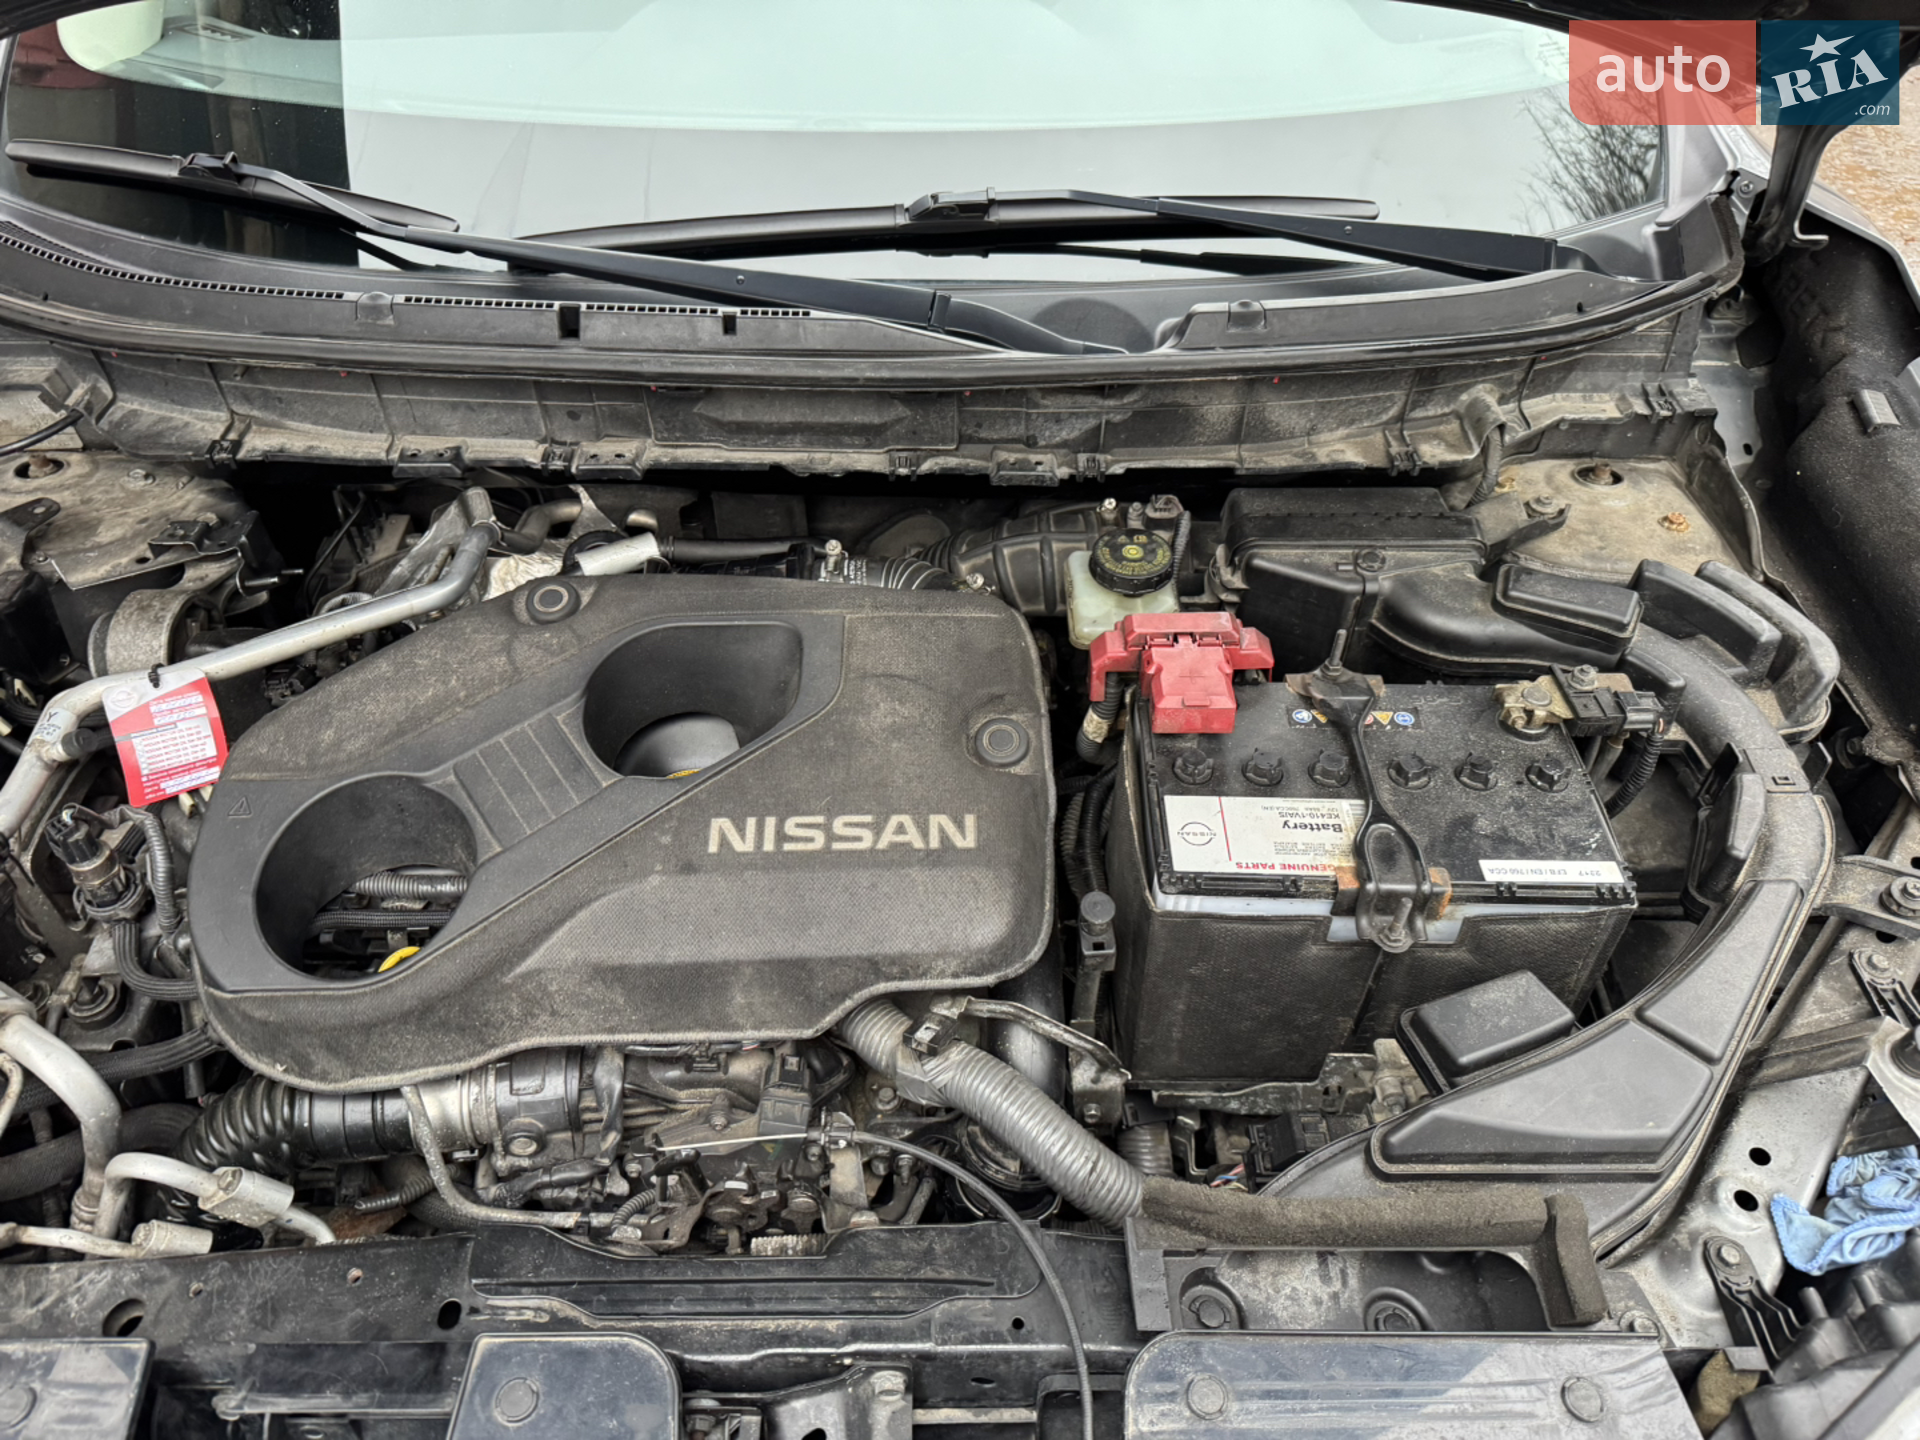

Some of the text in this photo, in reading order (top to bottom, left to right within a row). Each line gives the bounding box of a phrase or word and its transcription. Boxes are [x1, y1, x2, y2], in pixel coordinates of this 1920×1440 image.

[1282, 820, 1343, 833] Battery
[708, 814, 978, 853] NISSAN
[1236, 862, 1336, 872] GENUINE PARTS
